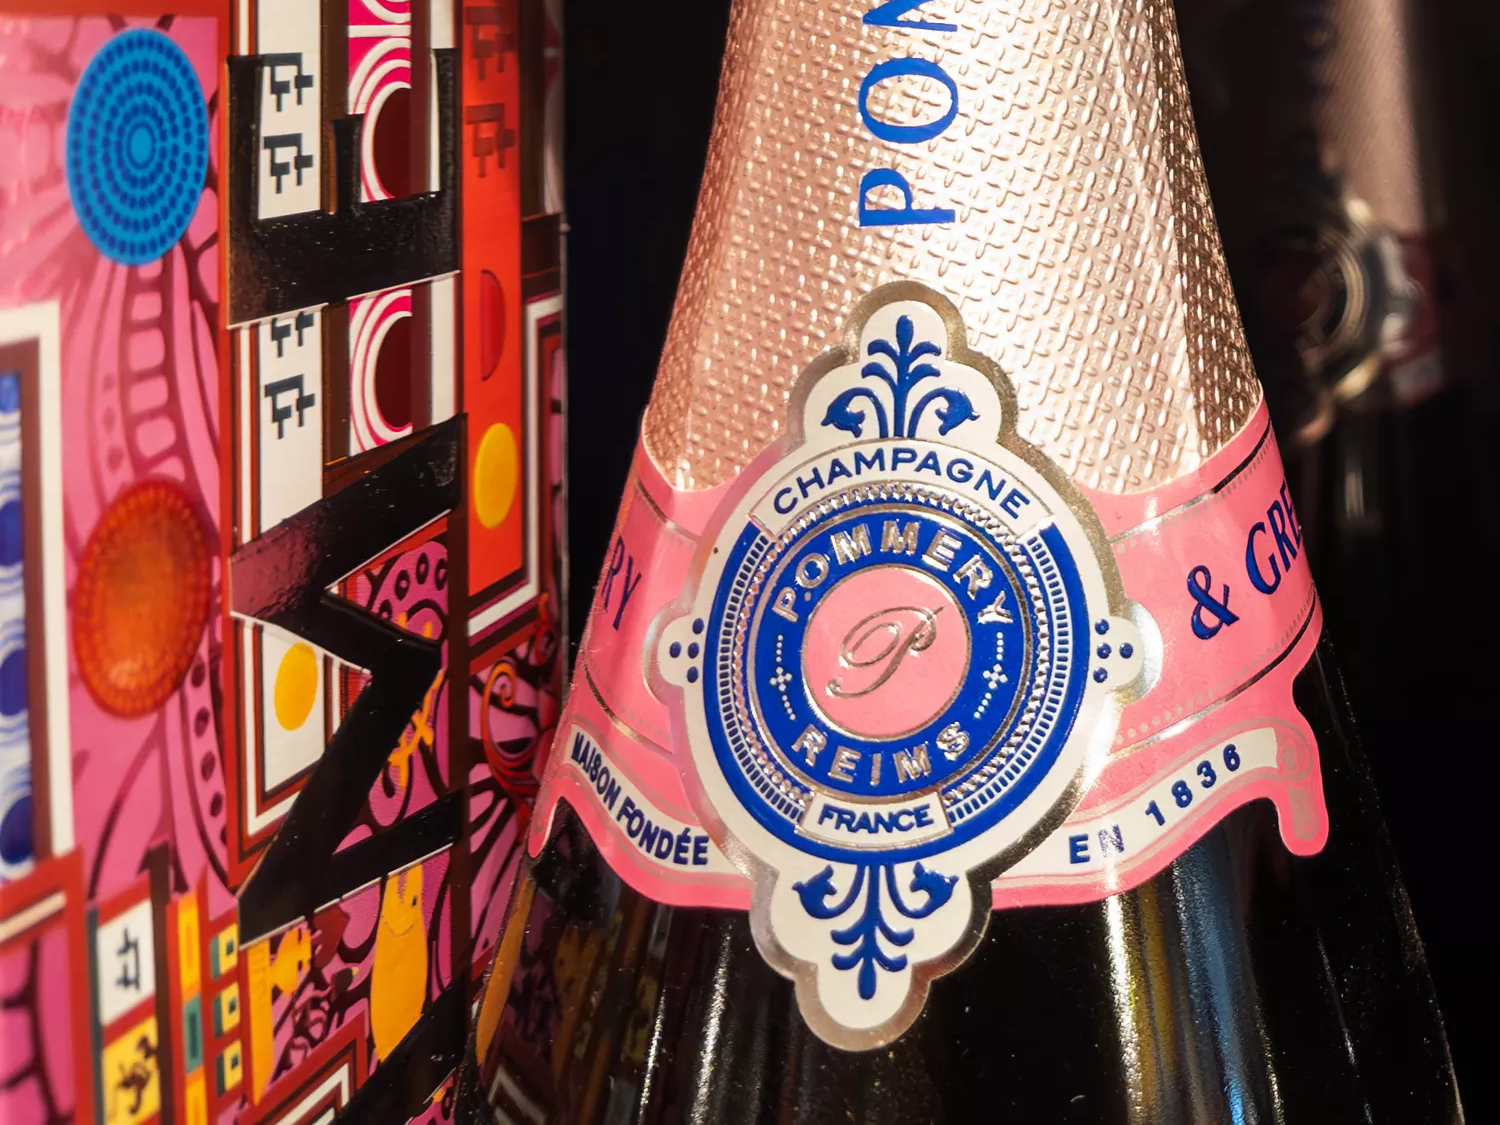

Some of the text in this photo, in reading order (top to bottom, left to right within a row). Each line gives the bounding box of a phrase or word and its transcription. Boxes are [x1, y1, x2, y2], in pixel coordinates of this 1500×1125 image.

[772, 447, 1031, 520] CHAMPAGNE
[771, 519, 1014, 624] POMMERY
[1186, 564, 1239, 640] &
[791, 721, 971, 786] REIMS
[616, 795, 710, 866] FONDÉE
[816, 803, 934, 835] FRANCE
[1068, 743, 1242, 865] EN 1836
